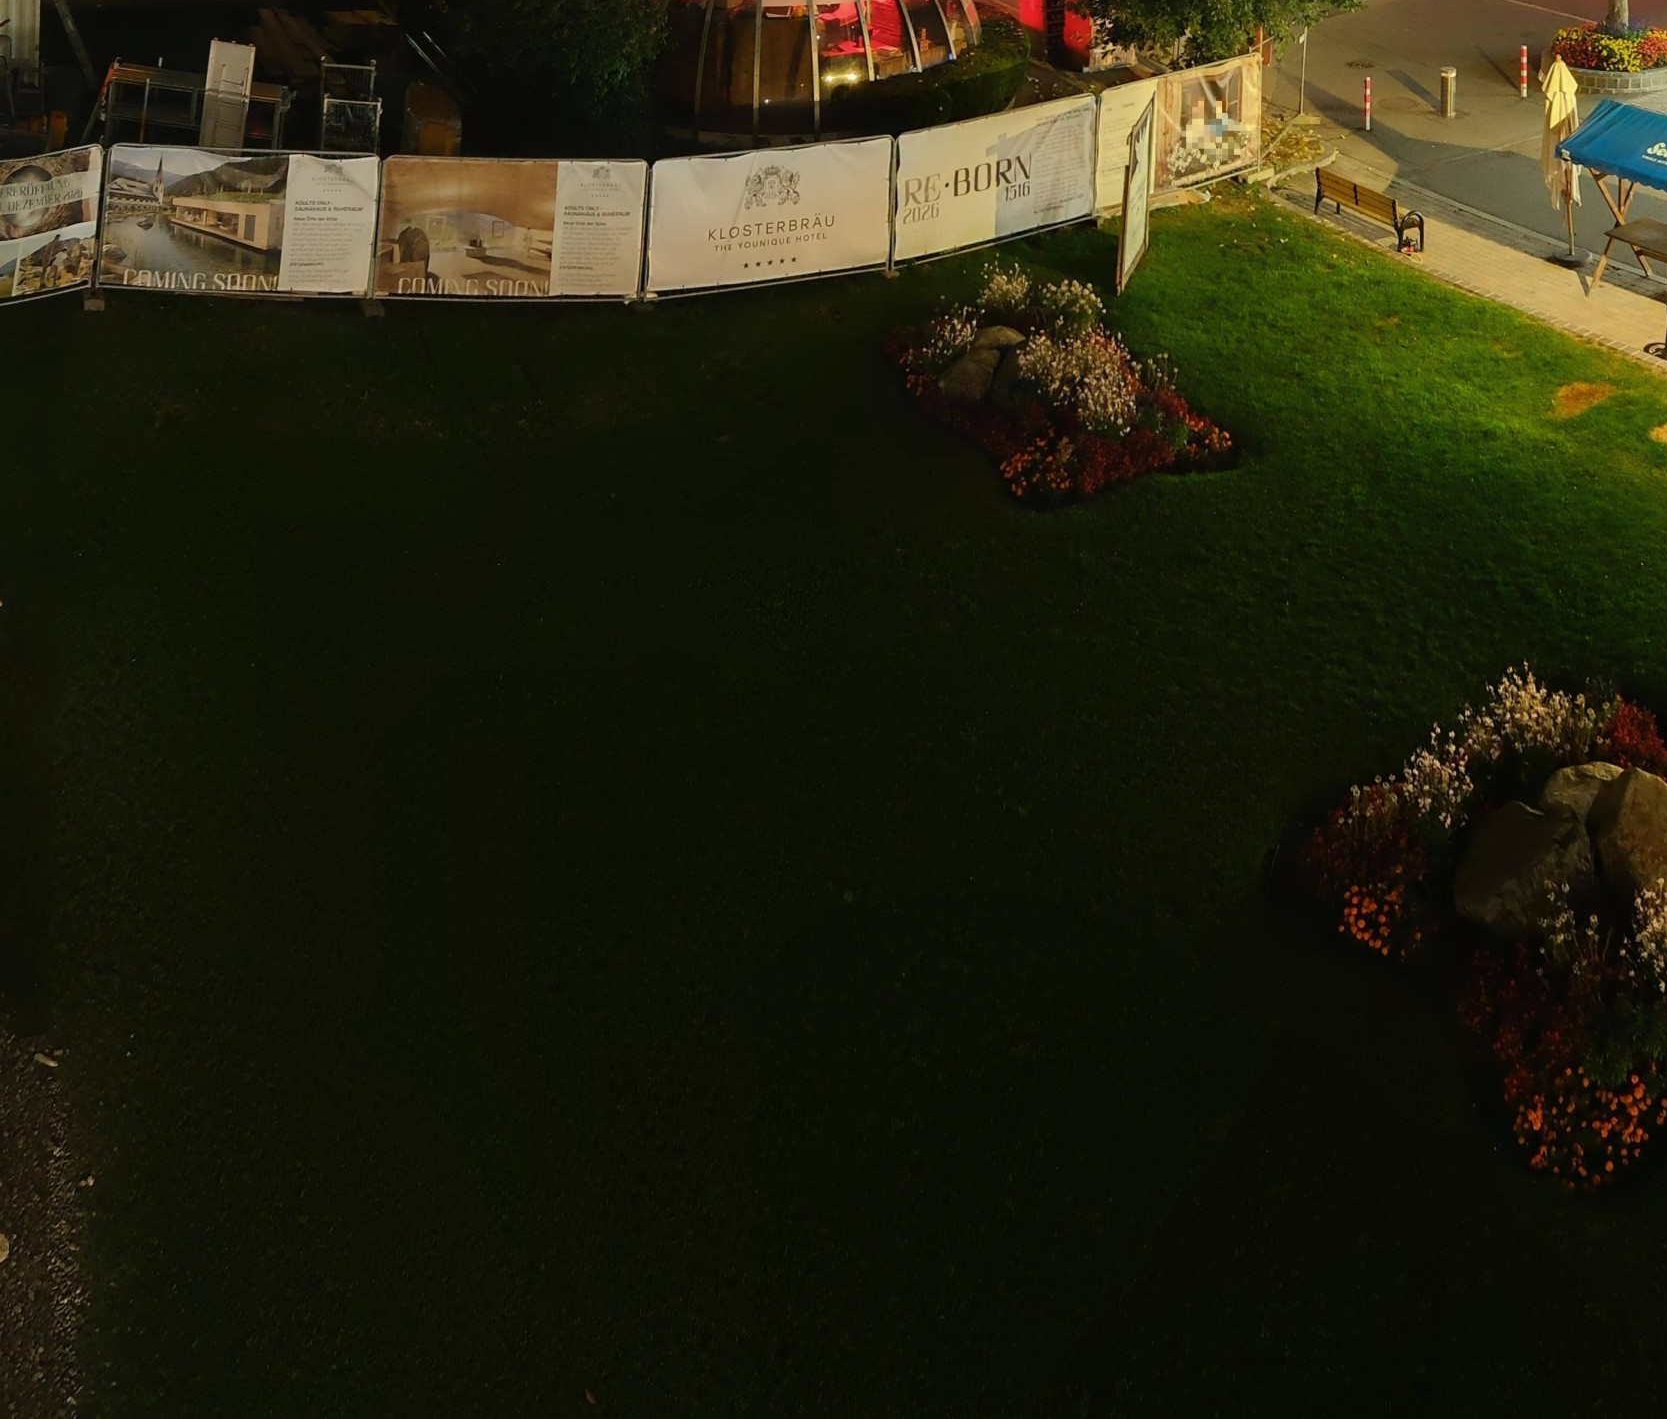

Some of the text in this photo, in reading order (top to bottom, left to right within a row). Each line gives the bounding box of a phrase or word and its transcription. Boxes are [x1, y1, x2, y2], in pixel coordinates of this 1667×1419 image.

[708, 213, 835, 241] KLOSTERBRÄU
[714, 233, 827, 252] THE YOUNIQUE HOTEL
[124, 268, 206, 289] COMING
